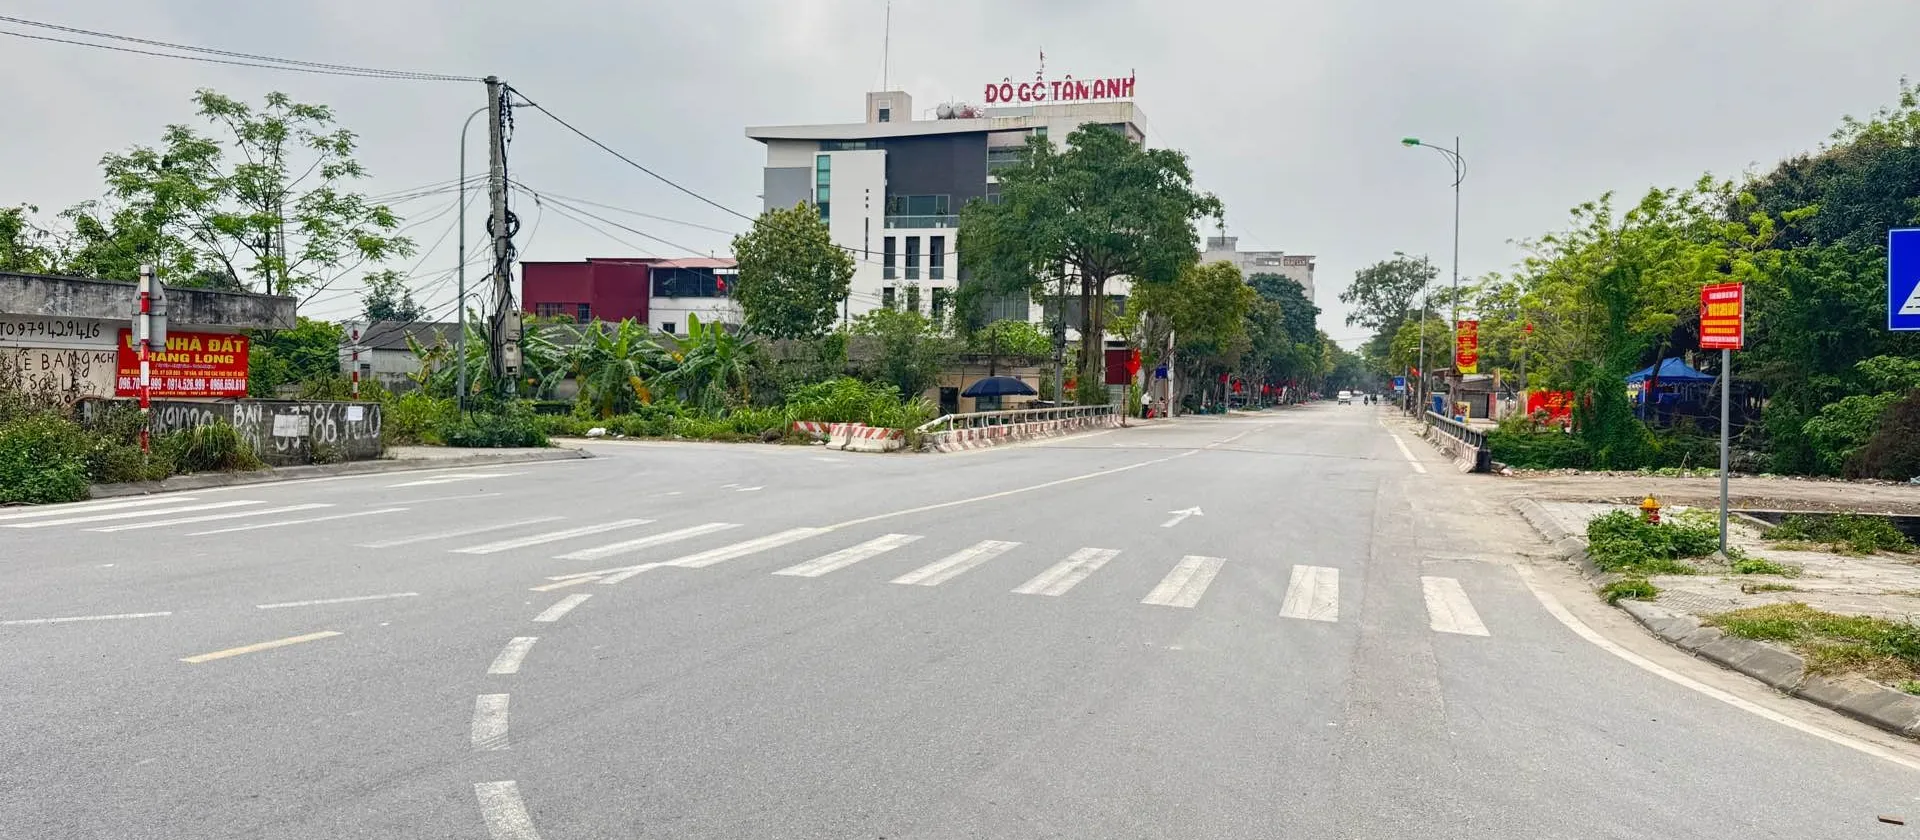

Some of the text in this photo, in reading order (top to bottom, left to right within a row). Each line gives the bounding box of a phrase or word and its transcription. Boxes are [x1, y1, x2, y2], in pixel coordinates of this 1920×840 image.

[1052, 74, 1089, 100] TÂN
[1092, 77, 1135, 100] ANH
[195, 354, 234, 364] LONG
